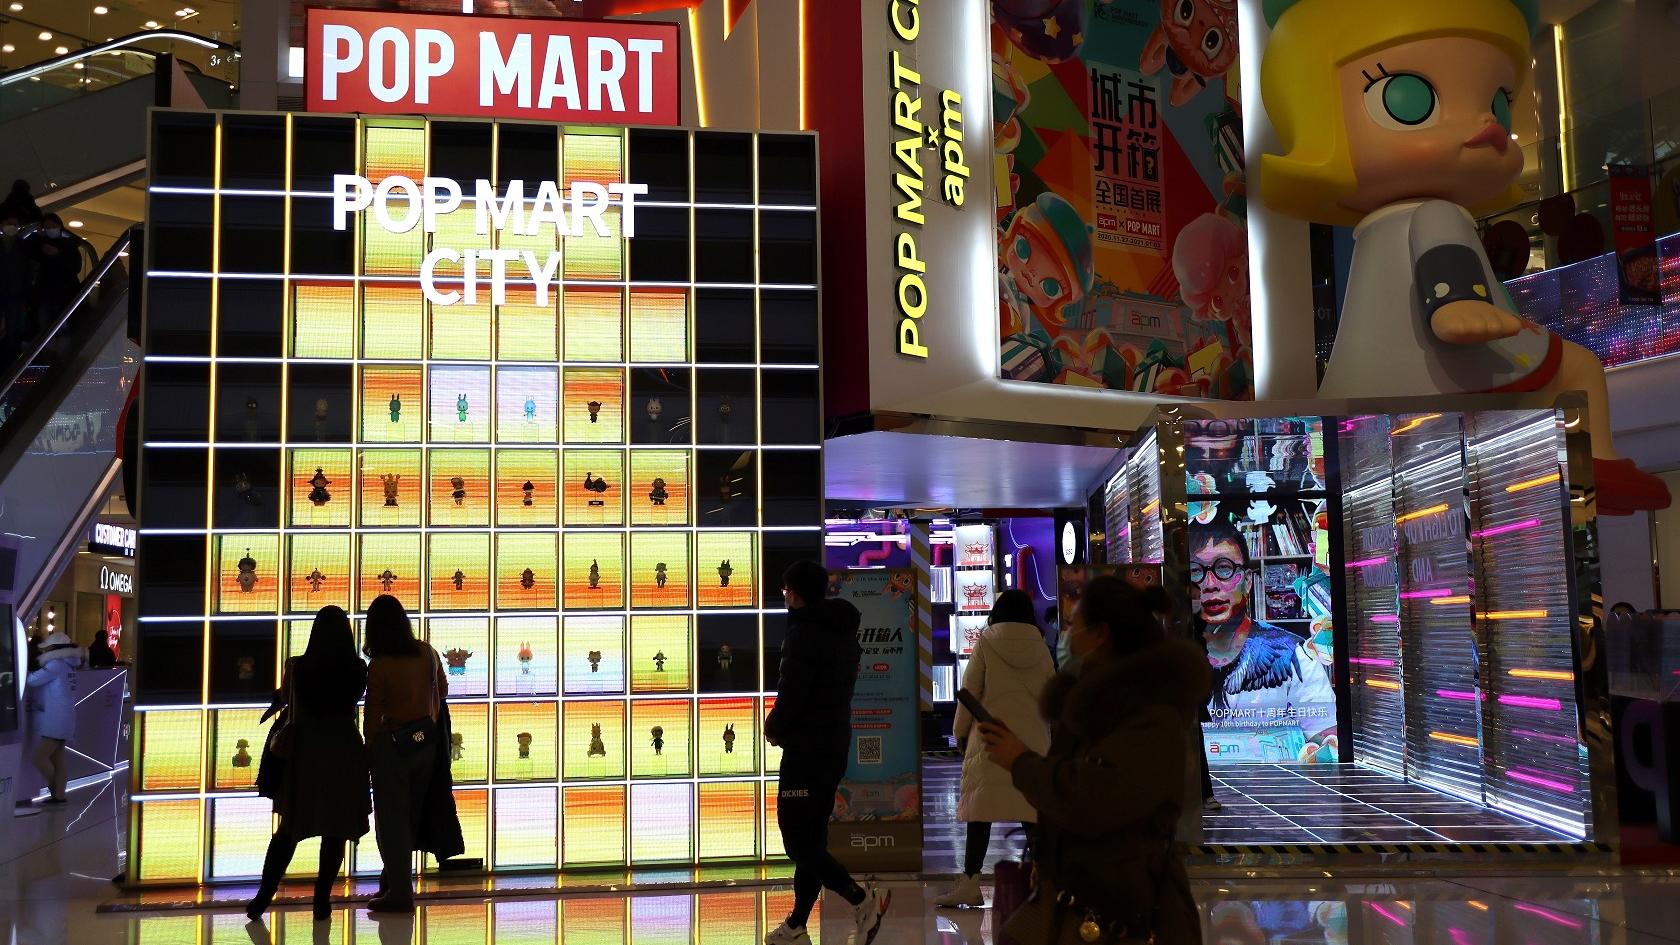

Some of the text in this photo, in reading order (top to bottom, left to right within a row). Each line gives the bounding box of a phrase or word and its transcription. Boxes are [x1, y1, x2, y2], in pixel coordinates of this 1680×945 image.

[321, 24, 664, 113] POP MART
[1091, 67, 1157, 129] 城市
[939, 89, 972, 207] apm
[1092, 121, 1160, 182] 开箱
[888, 0, 929, 359] POP MART C
[333, 174, 649, 238] POP MART
[1095, 179, 1161, 212] 全国首展
[1097, 215, 1116, 230] apm
[1126, 220, 1141, 234] POP
[1141, 223, 1161, 237] MART
[420, 248, 562, 307] CITY
[1131, 312, 1161, 331] apm
[95, 523, 125, 548] CUSTOMER
[109, 571, 133, 594] OMEGA
[1235, 719, 1261, 728] birthday
[1269, 719, 1299, 727] POPMART
[1210, 743, 1240, 756] apm
[781, 789, 809, 798] DICKIES
[850, 834, 896, 852] apm
